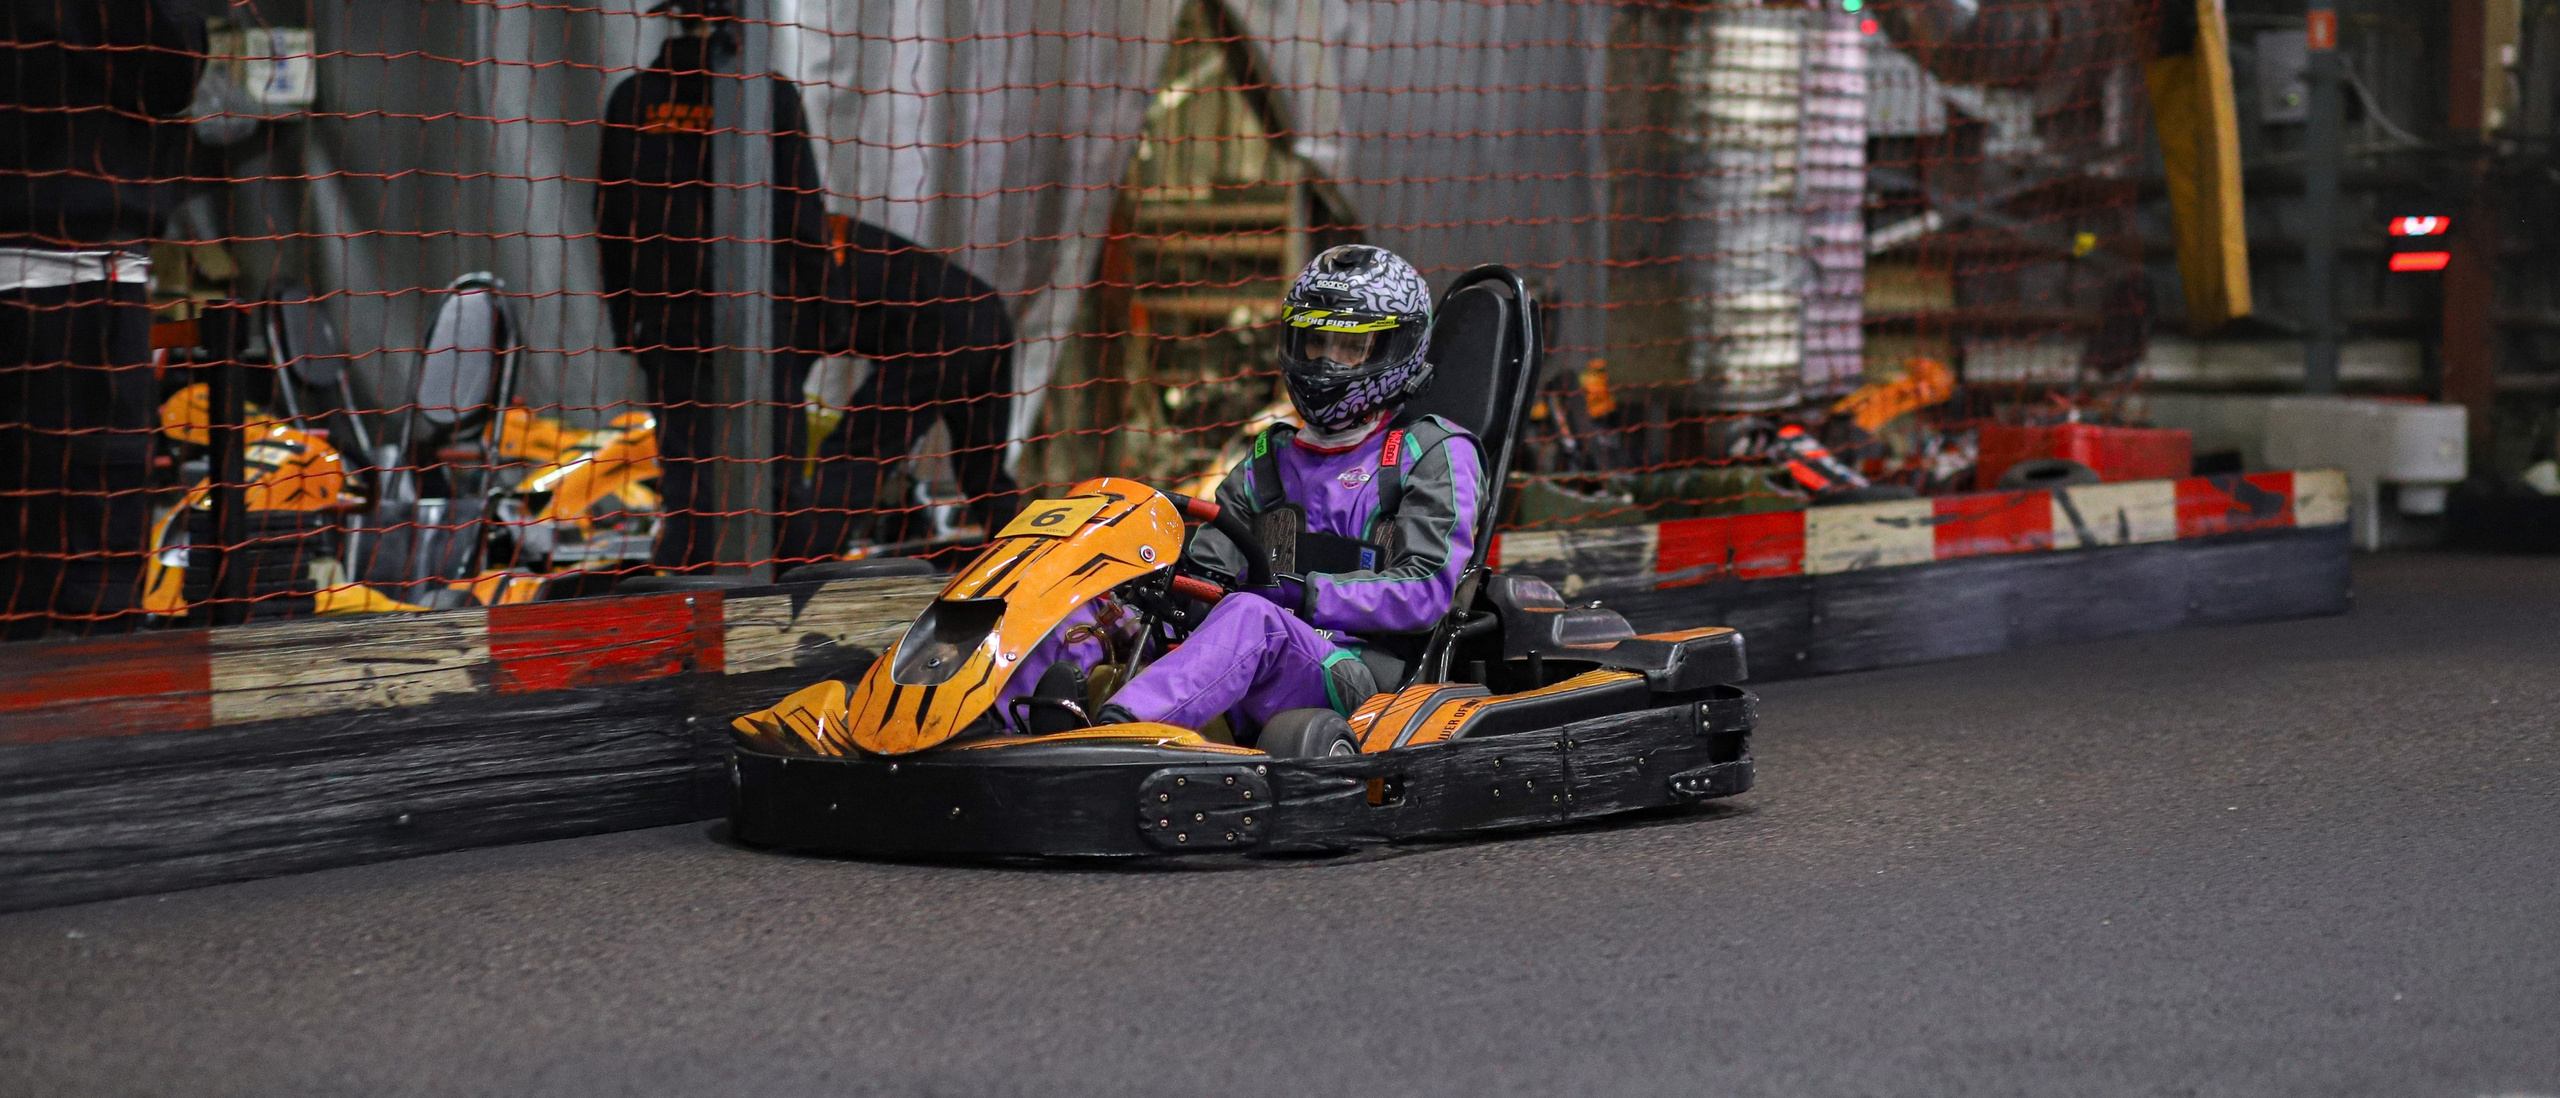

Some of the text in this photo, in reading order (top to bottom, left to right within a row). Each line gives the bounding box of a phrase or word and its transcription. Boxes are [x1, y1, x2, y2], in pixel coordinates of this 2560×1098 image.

[1316, 279, 1349, 291] sparco
[1293, 314, 1359, 328] BE THE FIRST
[1337, 472, 1371, 482] RLG
[1031, 507, 1073, 526] 6
